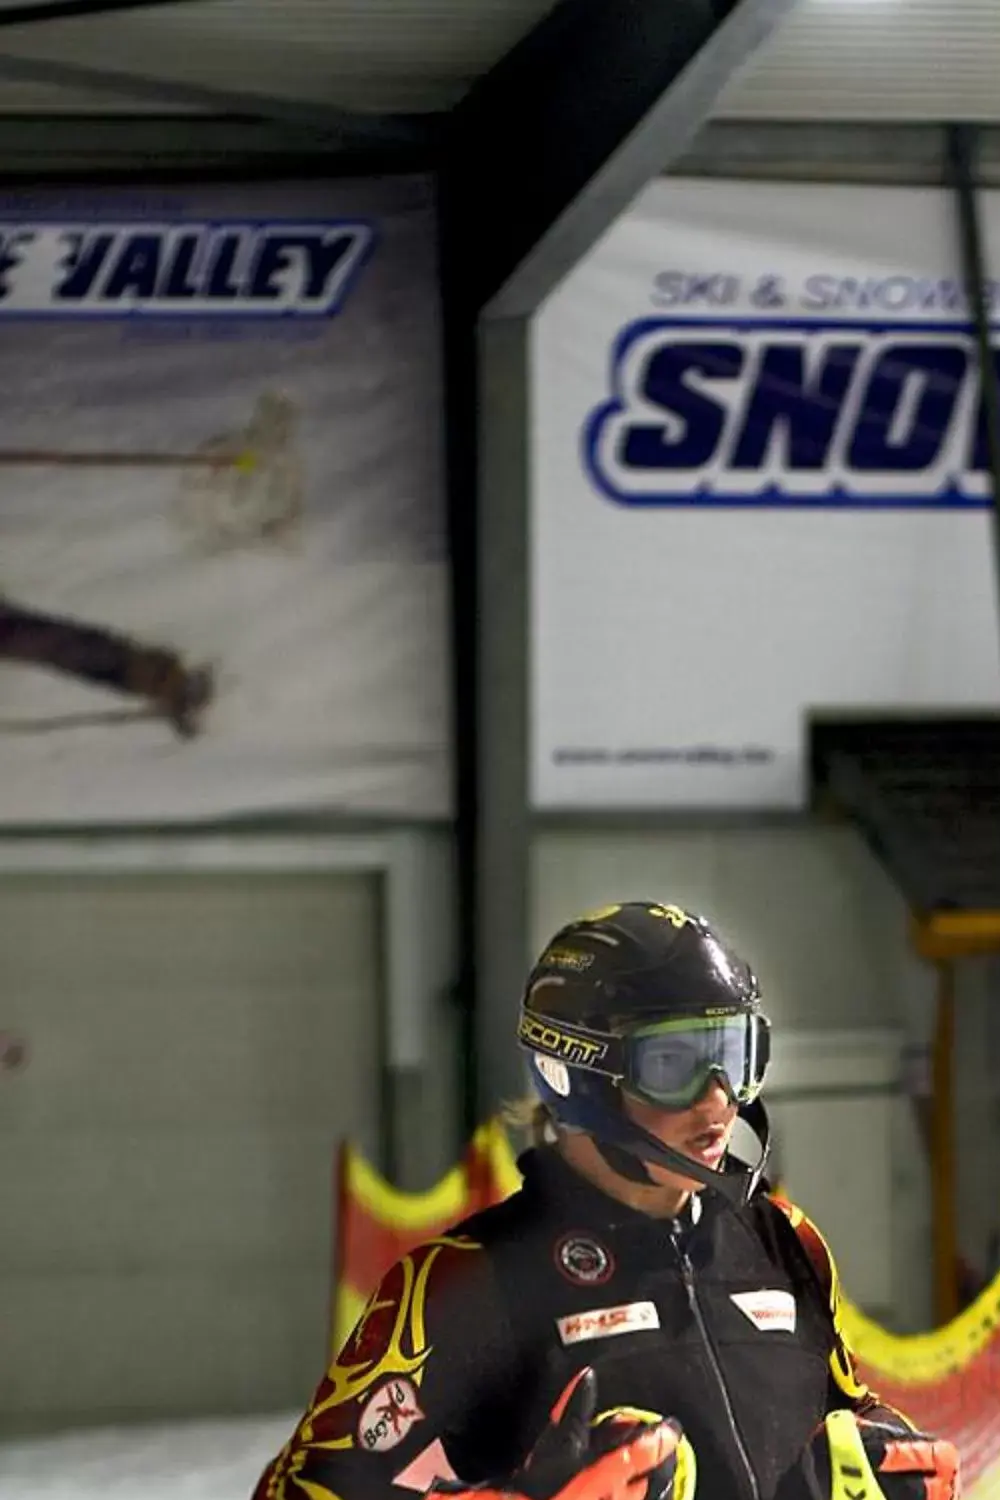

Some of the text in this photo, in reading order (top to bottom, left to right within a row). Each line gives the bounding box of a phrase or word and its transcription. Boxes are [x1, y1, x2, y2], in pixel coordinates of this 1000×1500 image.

[56, 231, 357, 299] VALLEY
[651, 270, 741, 308] SKI
[750, 272, 787, 309] &
[517, 1016, 601, 1062] SCOTT
